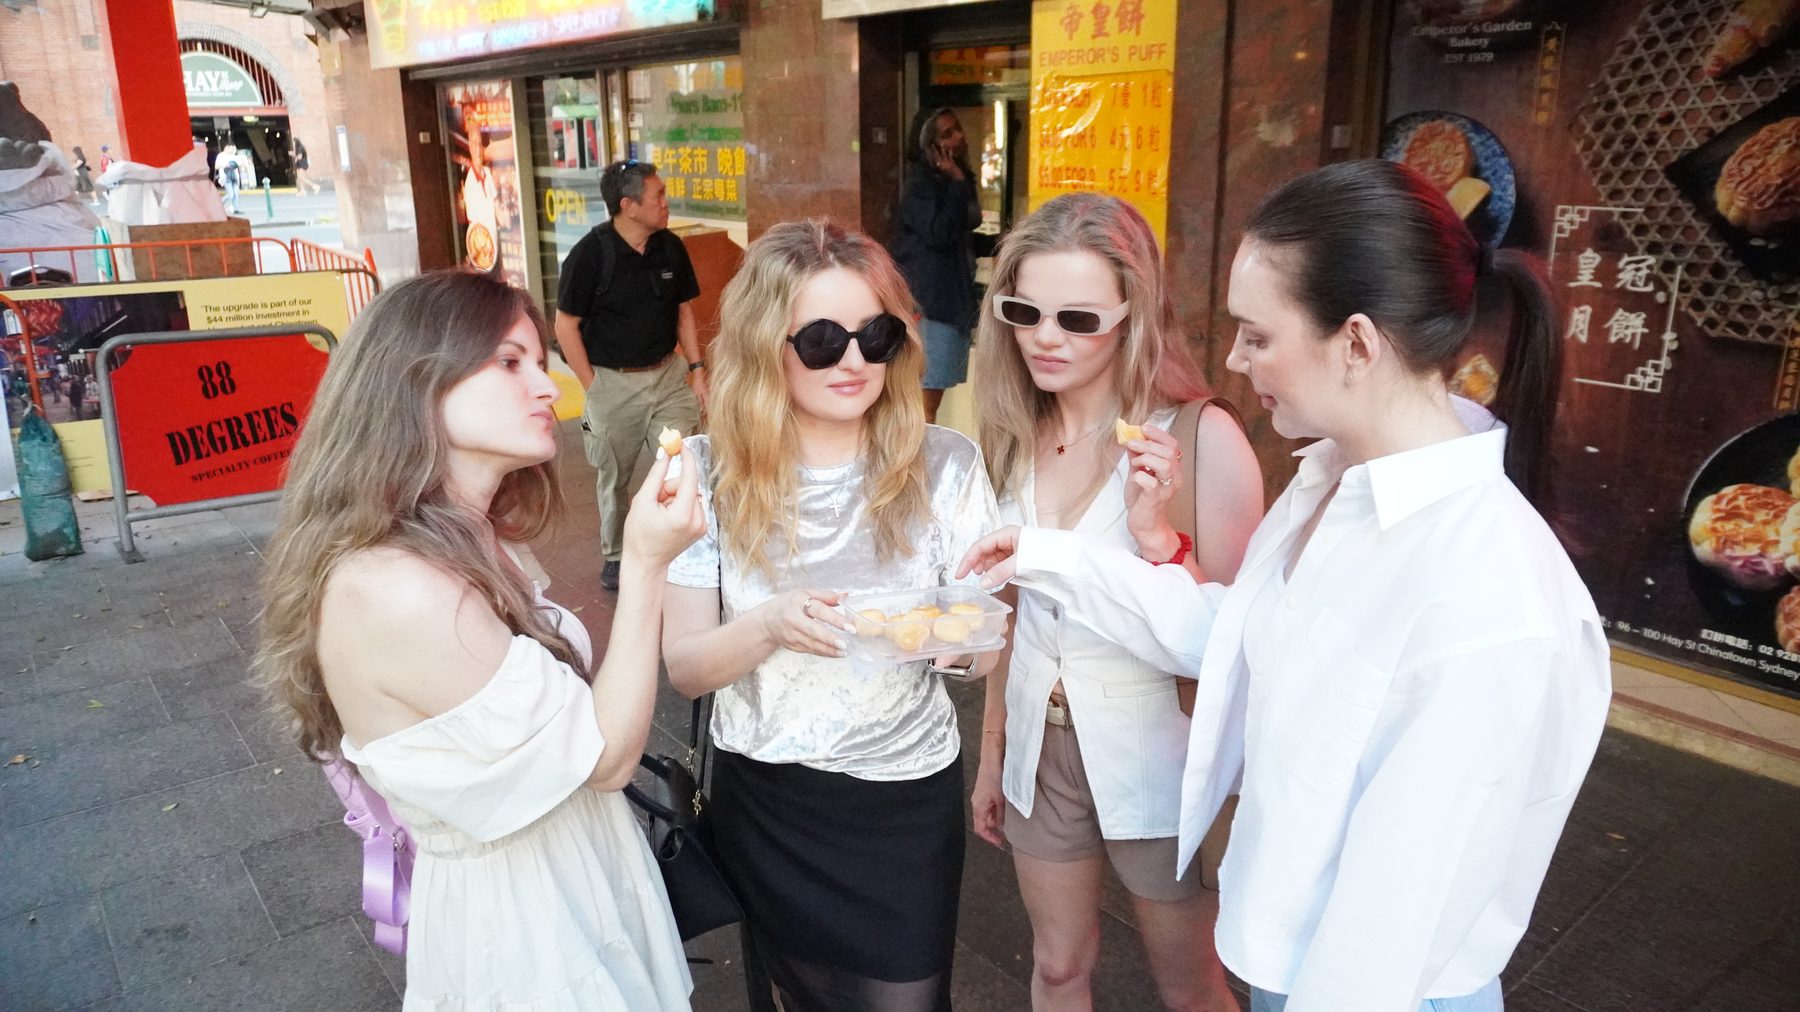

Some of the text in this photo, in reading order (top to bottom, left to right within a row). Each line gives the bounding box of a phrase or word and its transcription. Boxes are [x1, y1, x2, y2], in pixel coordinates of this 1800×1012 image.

[1412, 20, 1532, 38] Emperor's Garden
[1449, 37, 1490, 48] Bakery
[1039, 42, 1167, 67] EMPEROR'S PUFF
[1445, 51, 1494, 63] EST 1979
[545, 188, 586, 224] OPEN
[206, 315, 223, 324] $44
[225, 313, 254, 323] million
[255, 309, 300, 319] investment
[302, 308, 309, 316] in
[222, 302, 259, 313] upgrade
[261, 301, 268, 309] is
[270, 299, 287, 310] part
[288, 298, 297, 307] of
[1563, 304, 1649, 350] 月餅
[197, 361, 236, 399] 88
[166, 402, 299, 466] DEGREES
[191, 461, 250, 482] SPECIALTY
[1617, 620, 1631, 632] 96
[1643, 627, 1660, 640] 100
[1662, 633, 1683, 648] Hay
[1685, 640, 1696, 651] St
[1698, 643, 1756, 667] Chinatown
[1758, 660, 1800, 681] Sydney
[1758, 645, 1774, 656] 02
